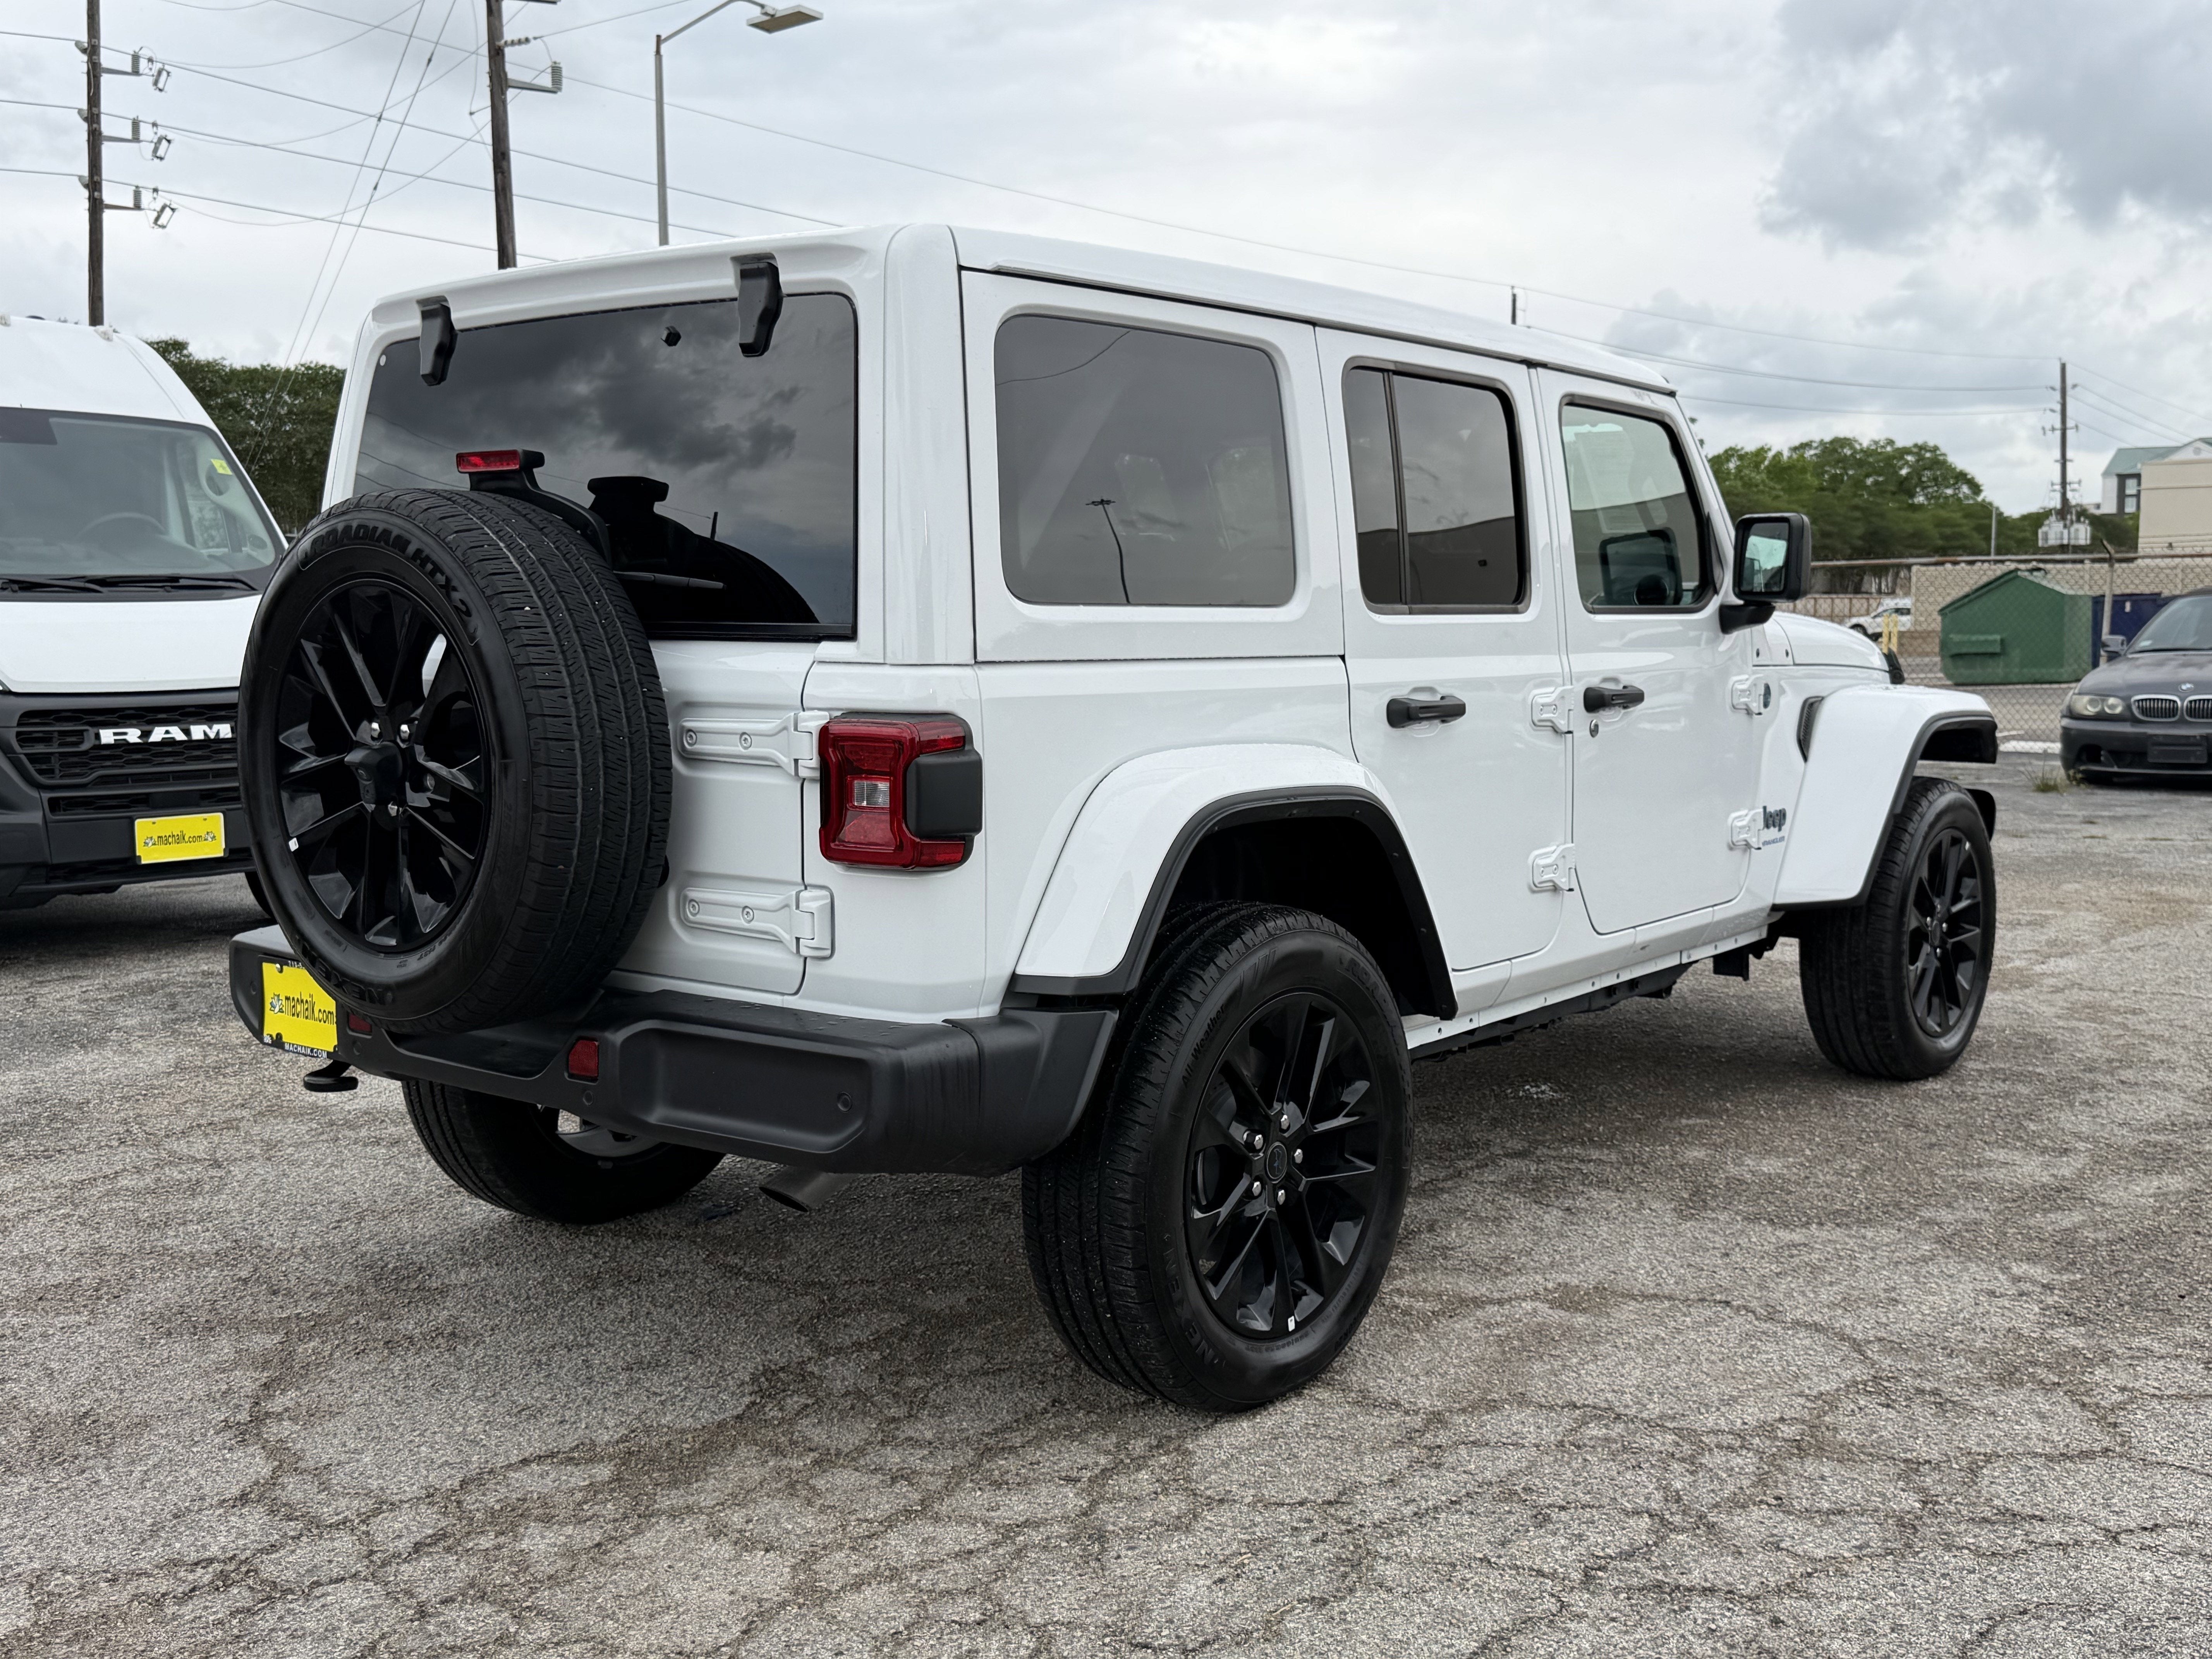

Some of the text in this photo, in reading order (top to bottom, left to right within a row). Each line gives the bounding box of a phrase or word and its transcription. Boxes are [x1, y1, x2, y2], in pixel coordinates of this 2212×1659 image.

[310, 524, 411, 555] ROADIAN
[99, 723, 232, 744] RAM
[157, 830, 203, 846] machaik.com
[302, 942, 387, 1006] NEXEN
[285, 991, 334, 1025] machaik.com
[285, 1042, 327, 1058] MACHAIK.COM
